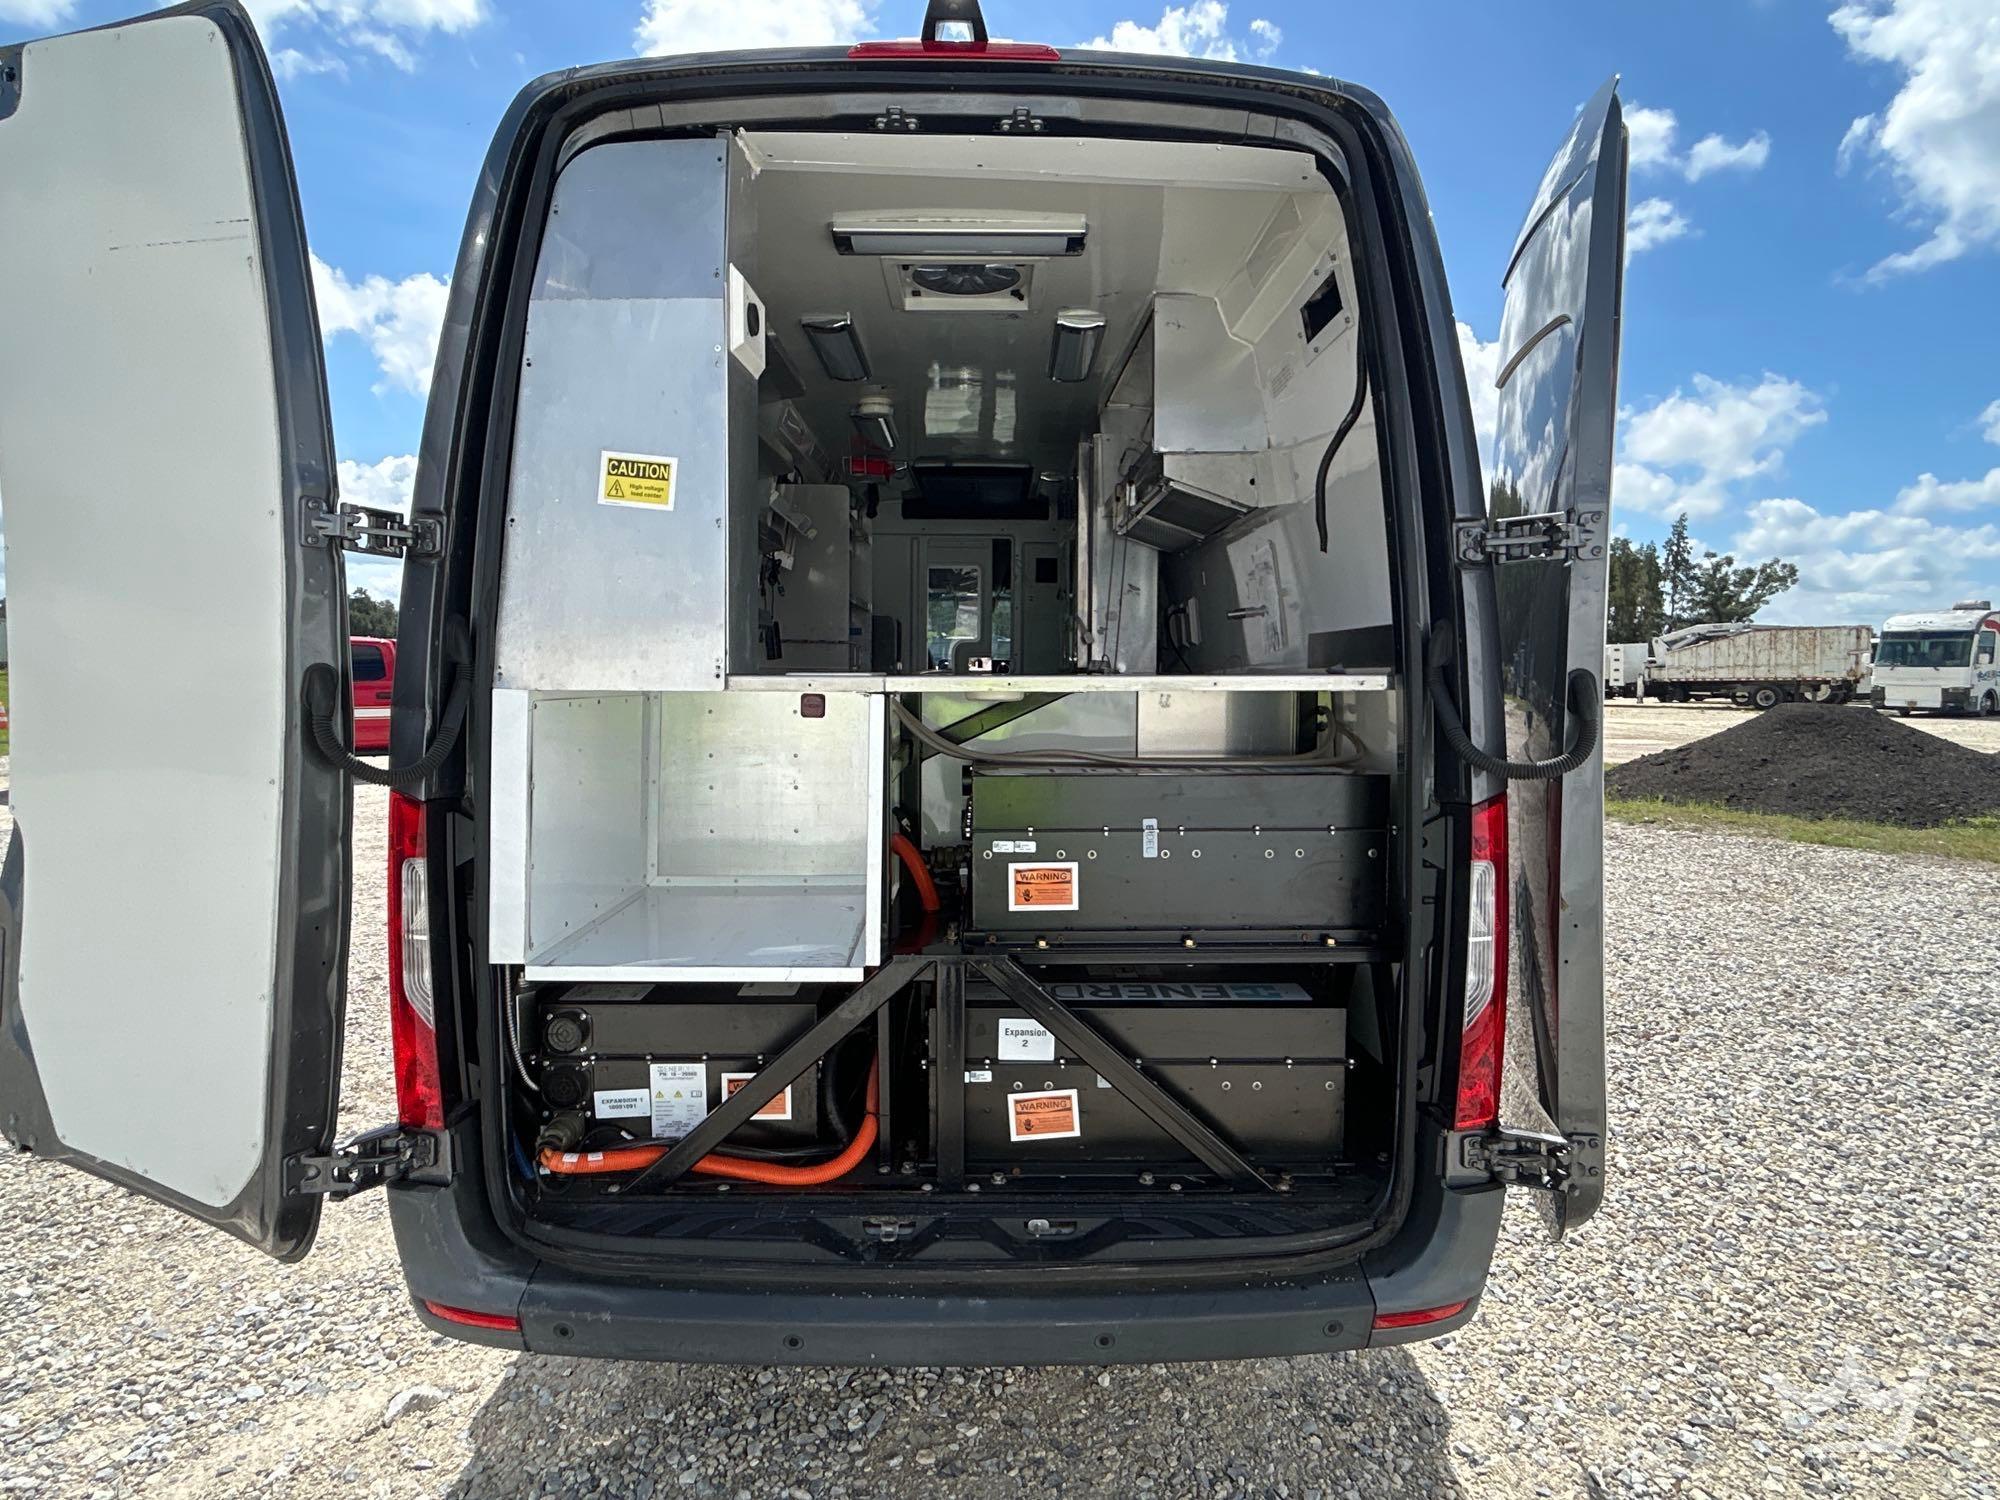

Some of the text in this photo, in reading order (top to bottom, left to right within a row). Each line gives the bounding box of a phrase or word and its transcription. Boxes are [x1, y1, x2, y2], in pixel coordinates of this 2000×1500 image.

[609, 460, 669, 480] CAUTION
[1020, 872, 1068, 881] WARNING
[1005, 1028, 1047, 1037] Expansion
[1021, 1039, 1029, 1048] 2
[1020, 1100, 1067, 1111] WARNING
